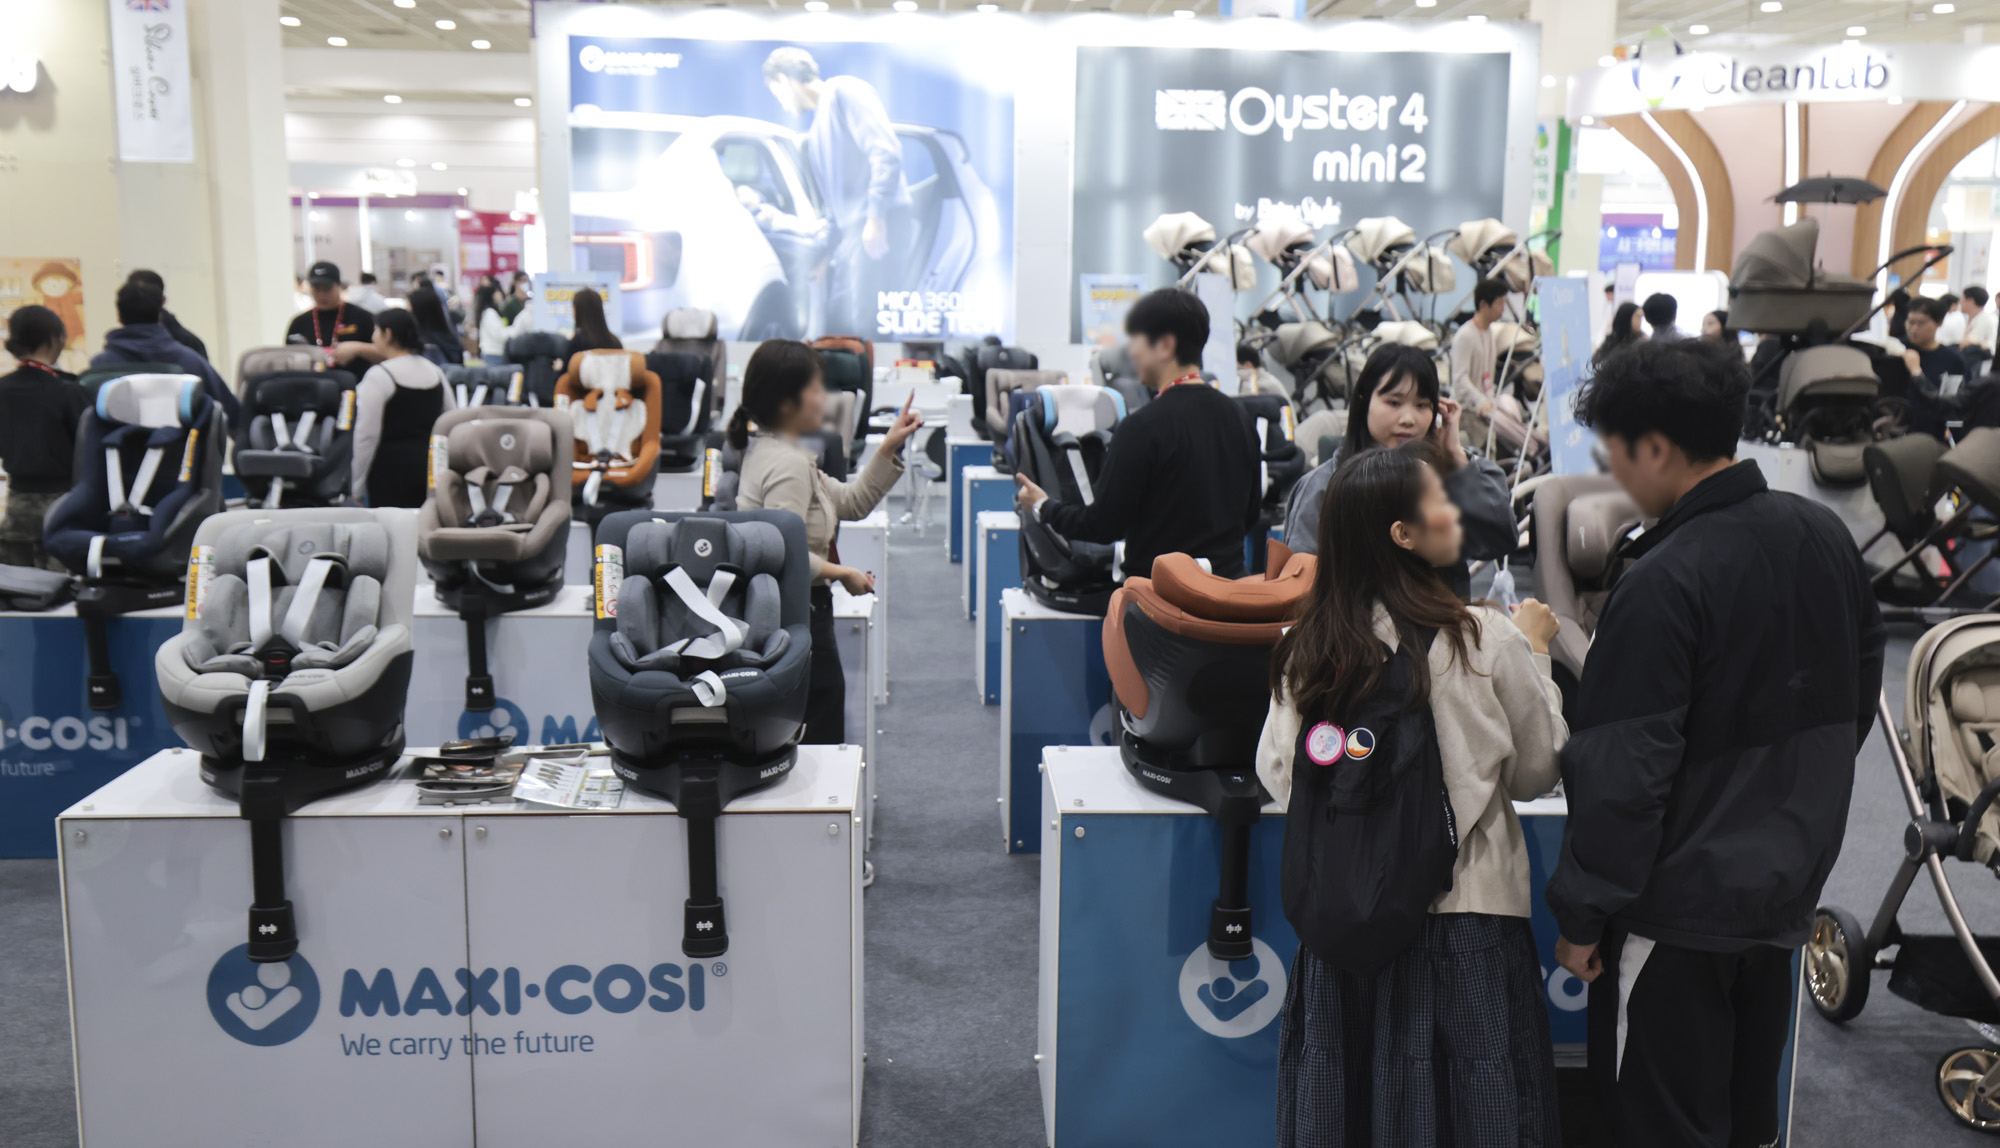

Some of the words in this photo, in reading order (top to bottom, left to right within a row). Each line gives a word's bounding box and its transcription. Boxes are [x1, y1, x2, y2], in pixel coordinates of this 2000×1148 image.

[877, 291, 923, 311] MICA
[876, 310, 942, 335] SLIDE
[341, 1033, 381, 1057] We
[389, 1037, 453, 1061] carry
[460, 1031, 507, 1056] the
[514, 1030, 595, 1055] future
